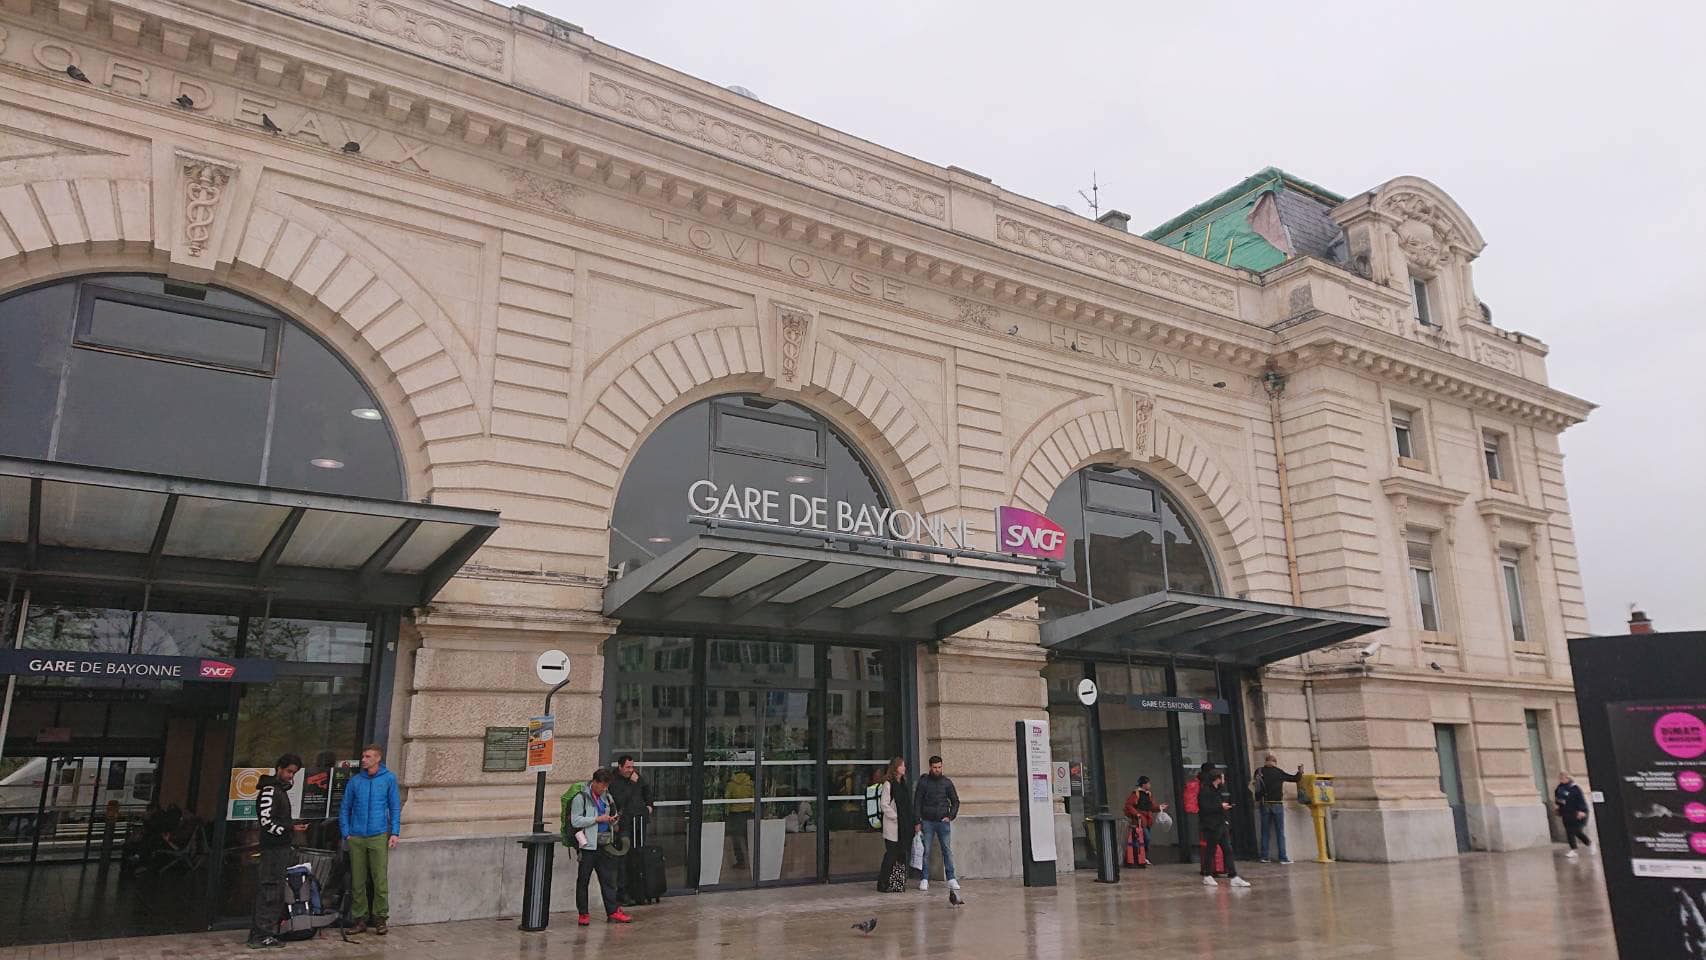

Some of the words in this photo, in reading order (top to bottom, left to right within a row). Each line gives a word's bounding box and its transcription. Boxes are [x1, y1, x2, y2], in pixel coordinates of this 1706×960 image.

[0, 26, 430, 173] ORDEAVX
[650, 211, 905, 305] TOVLOVSE
[1050, 326, 1206, 383] HENDAYE
[688, 480, 780, 524] GARE
[789, 494, 828, 529] DE
[837, 500, 976, 549] BAYONNE
[1005, 525, 1064, 551] SNCF
[29, 659, 76, 673] GARE
[80, 661, 101, 674] DE
[106, 663, 182, 677] BAYONNE
[201, 666, 234, 676] SNCF
[1141, 699, 1158, 709] GARE
[1158, 701, 1167, 709] DE
